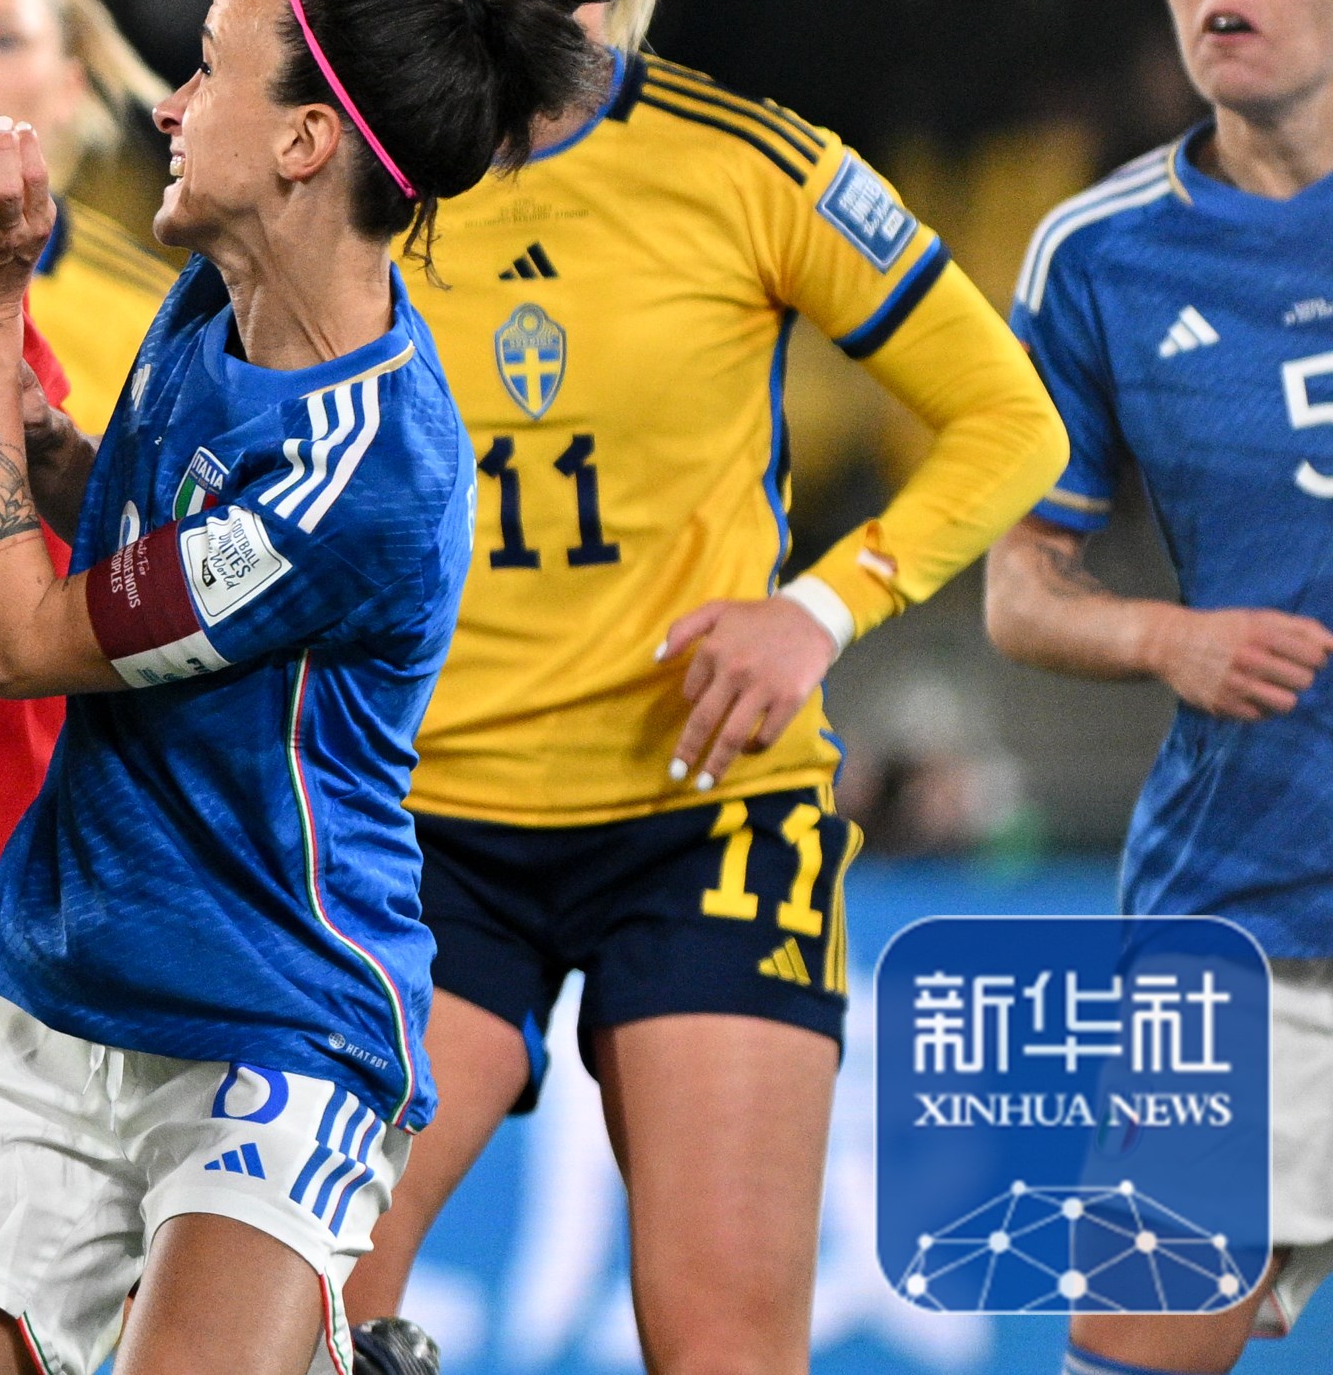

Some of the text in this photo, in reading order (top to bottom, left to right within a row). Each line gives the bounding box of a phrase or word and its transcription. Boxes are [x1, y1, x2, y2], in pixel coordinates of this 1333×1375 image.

[192, 453, 223, 490] ITALIA
[478, 432, 620, 569] 11
[218, 531, 251, 579] UNITES
[232, 517, 260, 569] FOOTBALL
[700, 800, 824, 937] 11
